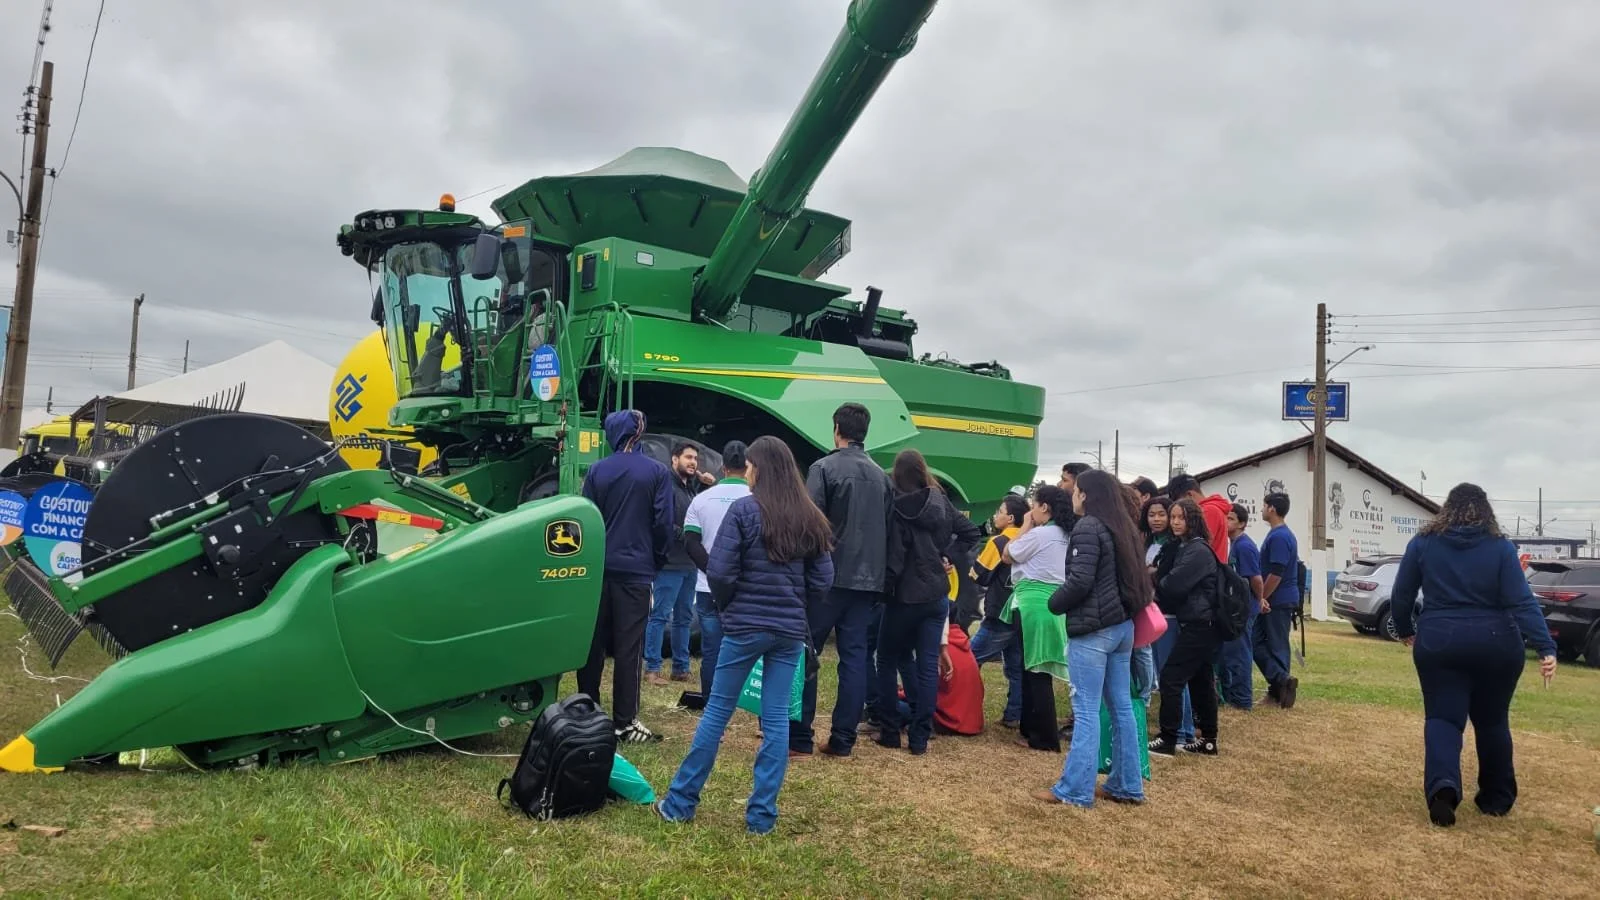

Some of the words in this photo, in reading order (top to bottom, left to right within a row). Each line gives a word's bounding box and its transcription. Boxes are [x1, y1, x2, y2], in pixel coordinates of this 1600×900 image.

[967, 422, 988, 432] JOHN
[990, 425, 1014, 435] DEERE
[40, 495, 92, 514] GOSTOU
[1349, 510, 1383, 522] CENTRAL
[1391, 516, 1417, 526] PRESENTE
[31, 523, 57, 536] COM
[60, 529, 68, 538] A
[541, 566, 587, 580] 740FD
